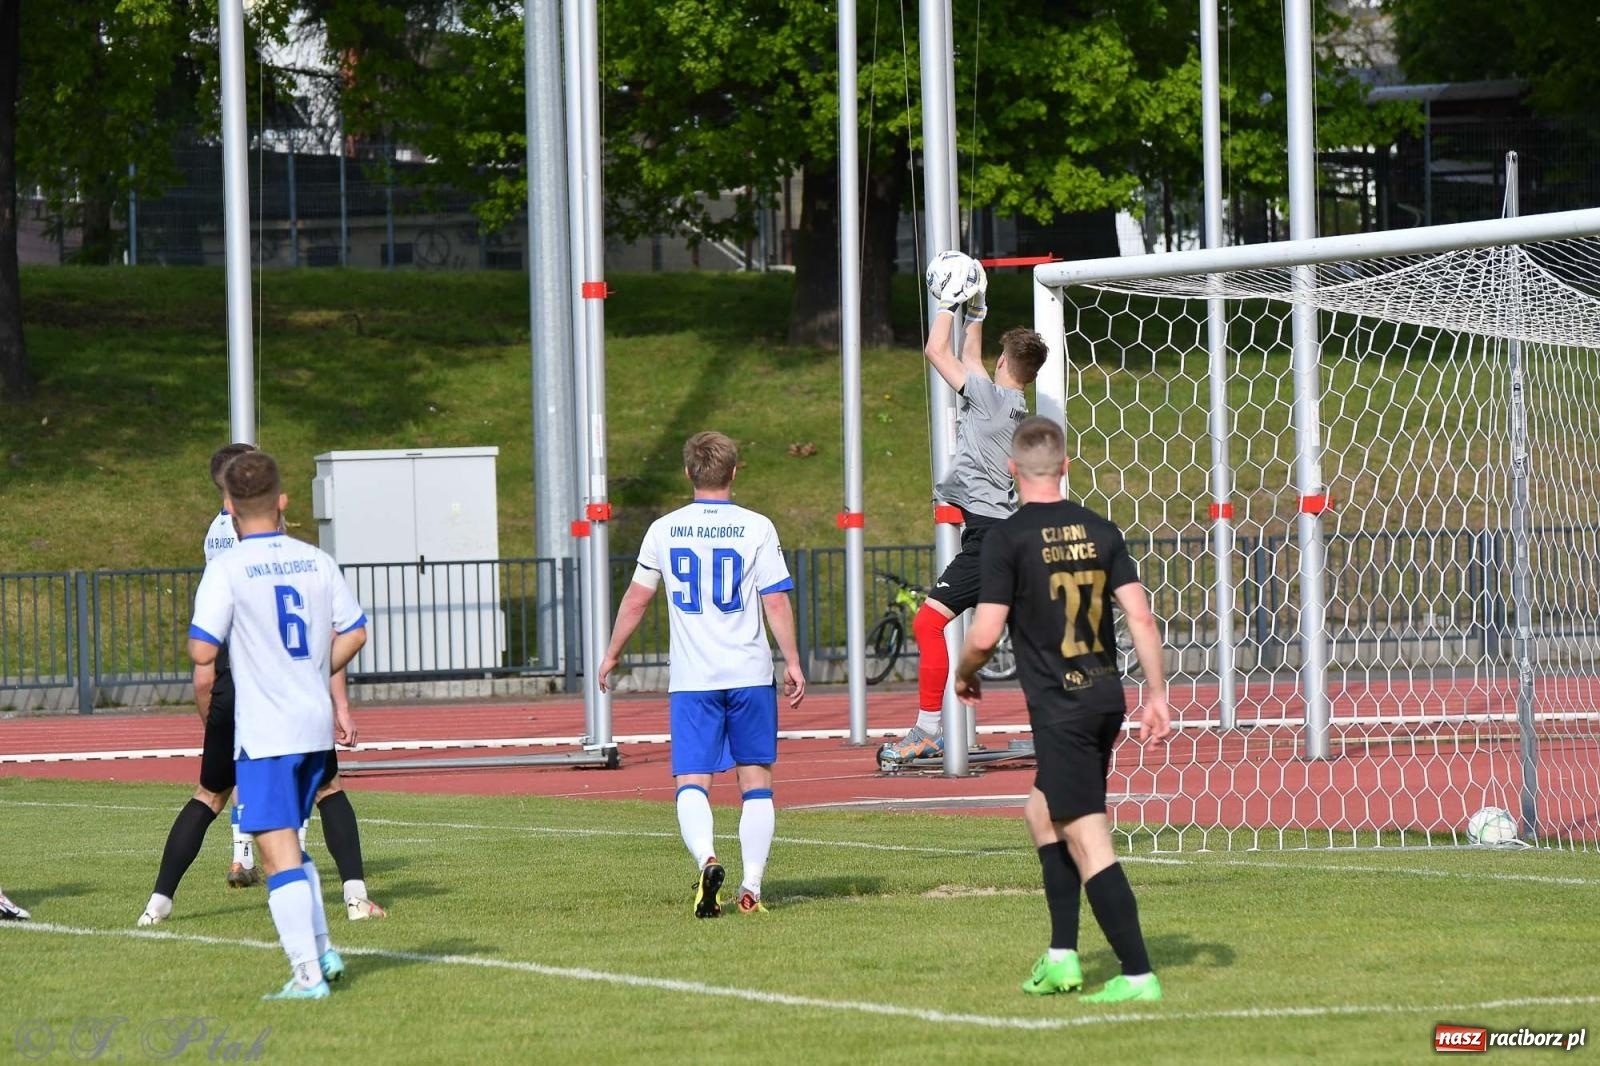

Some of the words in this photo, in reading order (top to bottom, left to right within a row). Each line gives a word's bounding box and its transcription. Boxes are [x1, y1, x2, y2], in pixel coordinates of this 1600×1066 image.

[670, 525, 694, 538] UNIA
[696, 523, 745, 539] RACIBÓRZ
[246, 562, 271, 578] UNIA
[669, 547, 745, 615] 90
[273, 585, 312, 661] 6
[1049, 569, 1107, 659] 27
